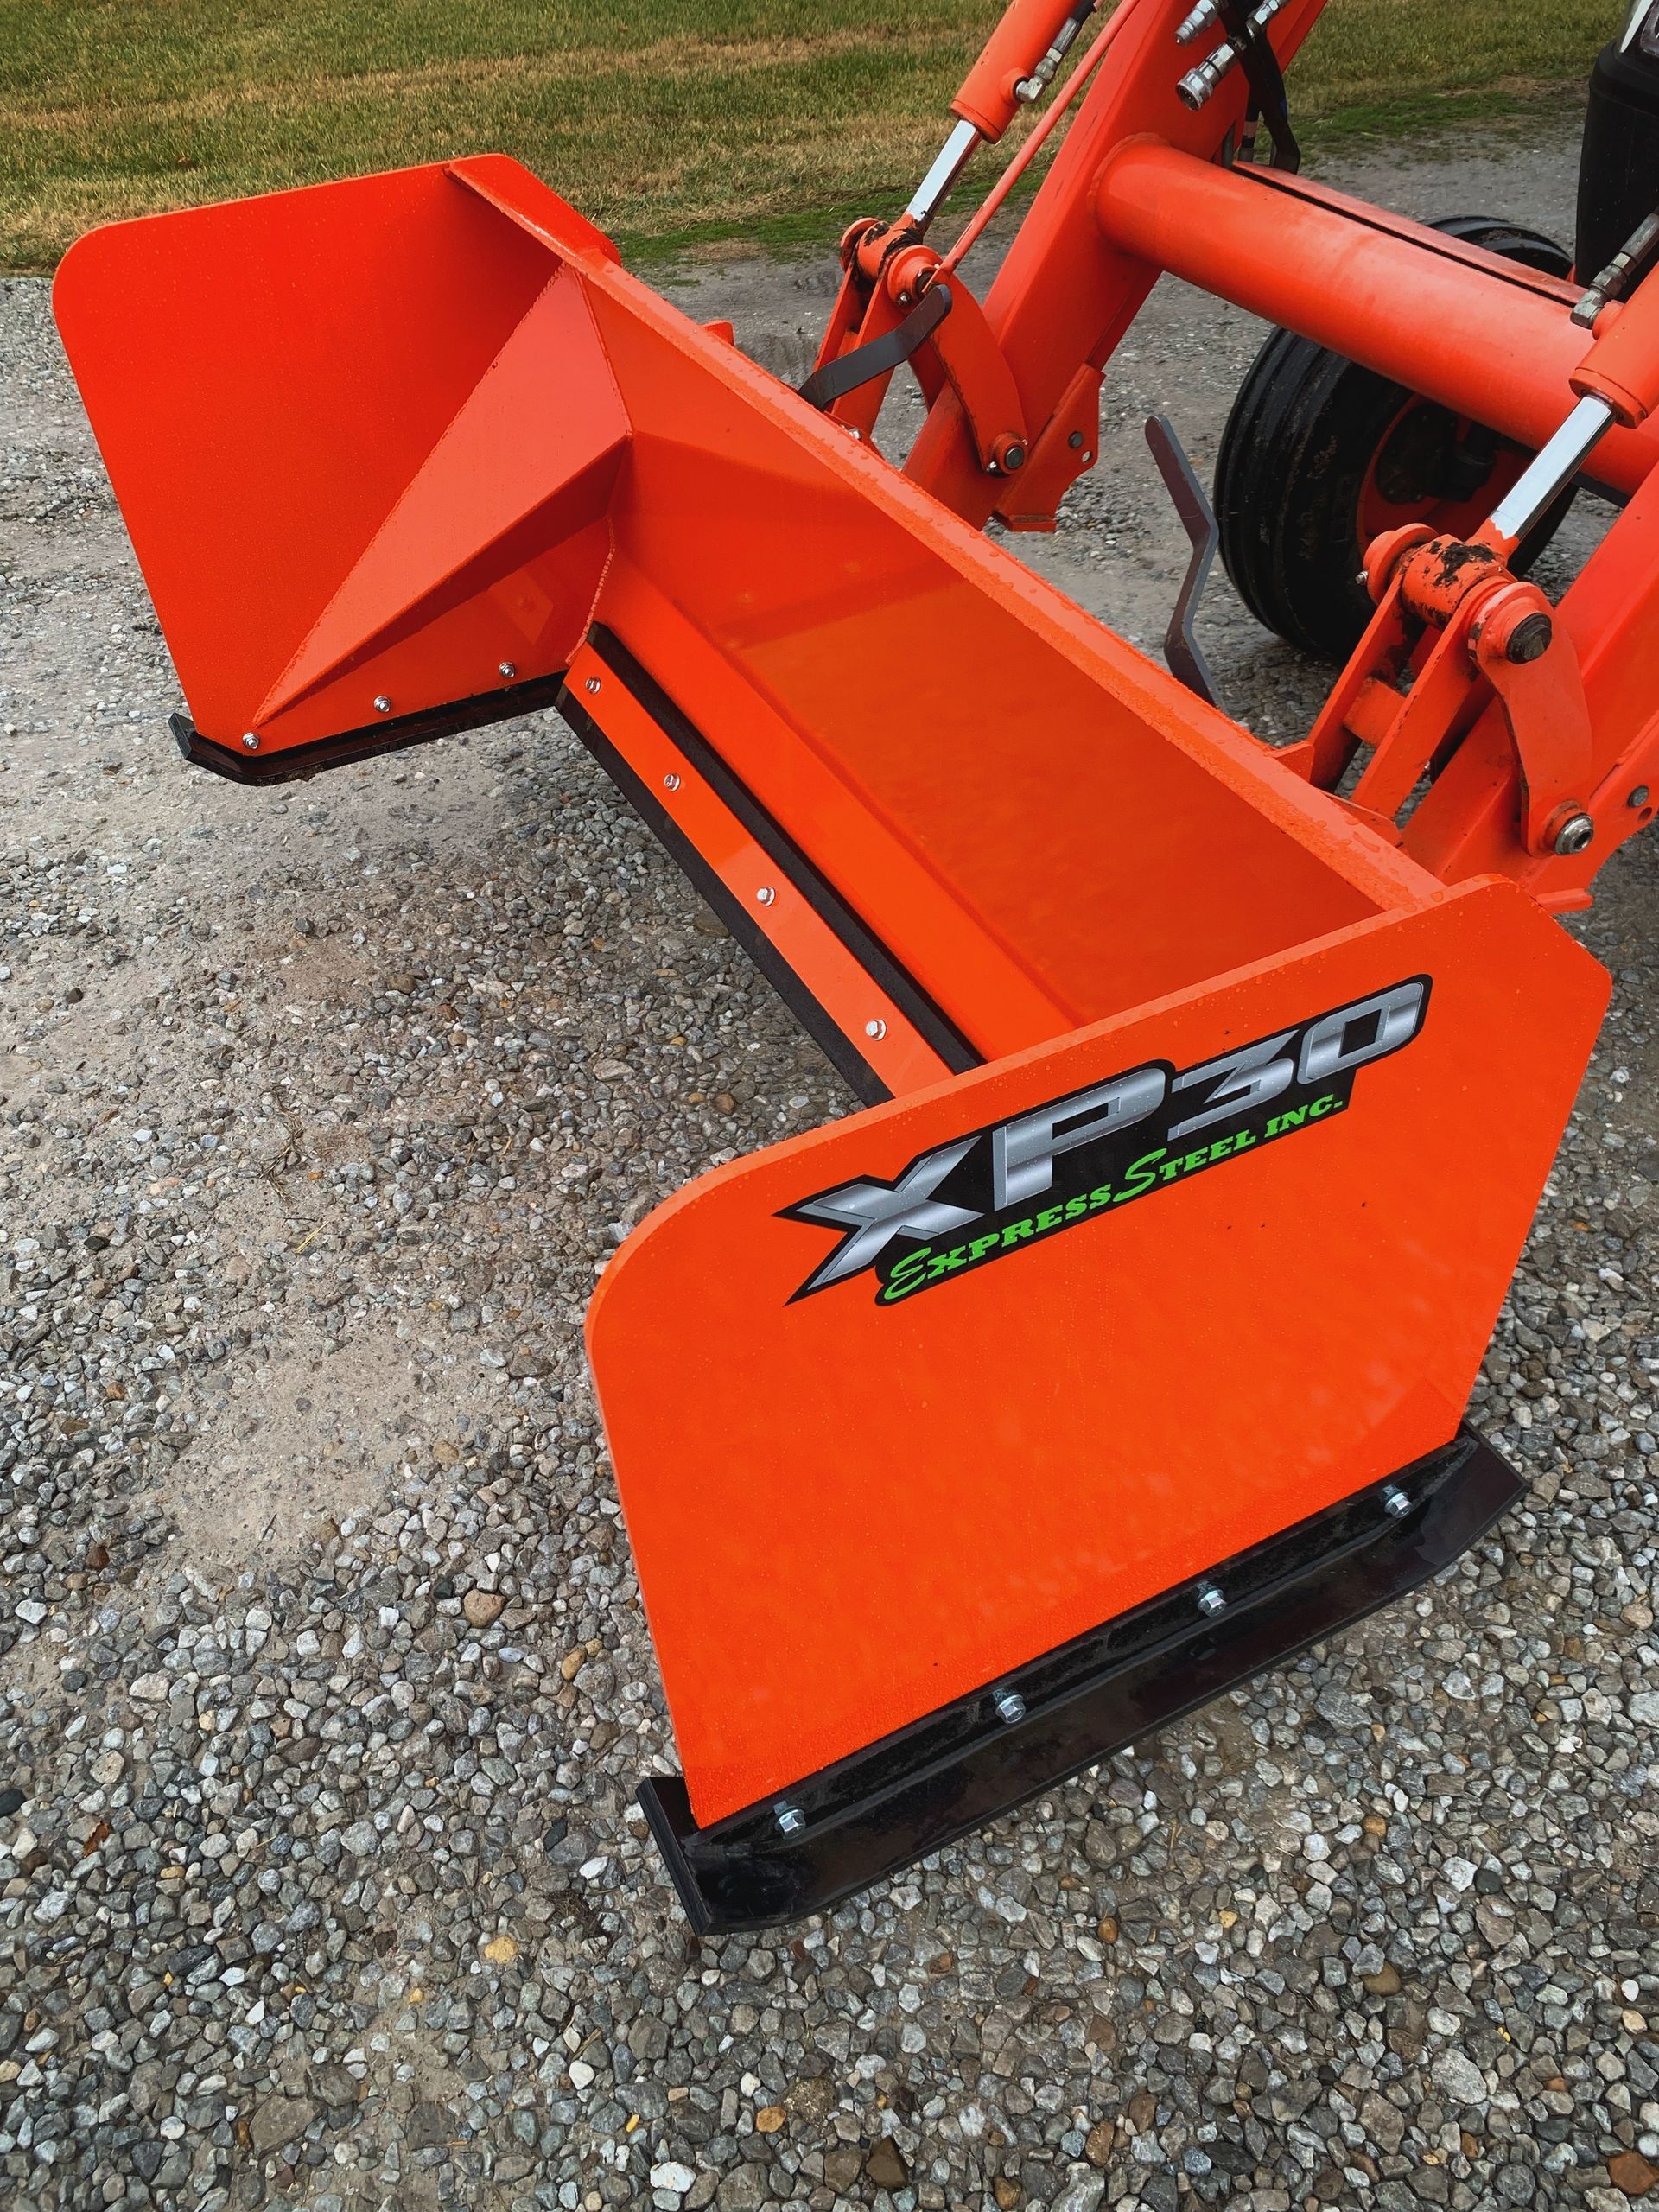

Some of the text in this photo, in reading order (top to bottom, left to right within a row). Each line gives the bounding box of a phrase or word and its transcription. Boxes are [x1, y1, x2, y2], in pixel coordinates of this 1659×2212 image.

[796, 982, 1424, 1291] XP30
[883, 1094, 1344, 1300] EXPRESS STEEL INC.
